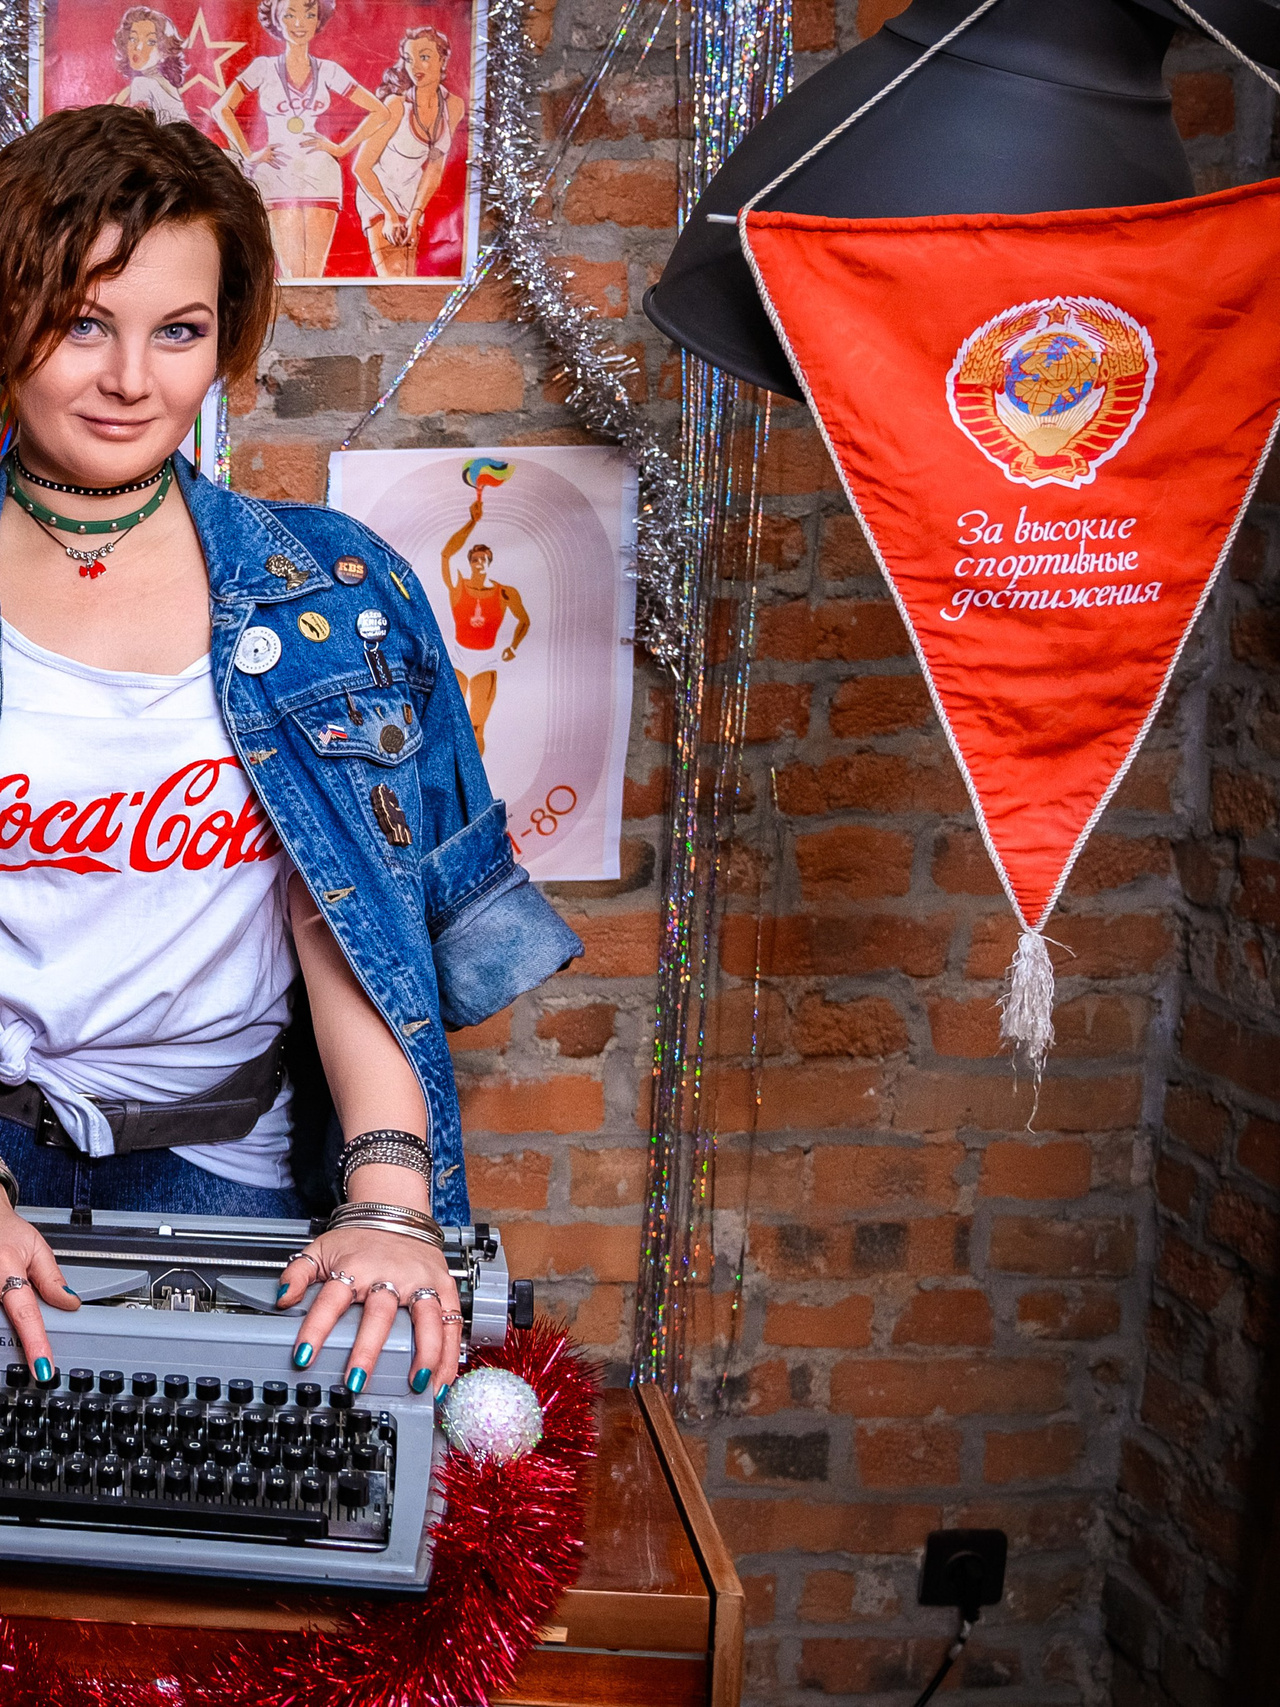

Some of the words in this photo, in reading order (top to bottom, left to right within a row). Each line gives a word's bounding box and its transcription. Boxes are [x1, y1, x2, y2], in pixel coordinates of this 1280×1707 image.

[276, 98, 325, 113] СССР
[956, 509, 1003, 546] За
[1014, 505, 1137, 542] высокие
[338, 561, 364, 574] KBS
[954, 539, 1139, 590] спортивные
[940, 580, 1163, 622] достижения
